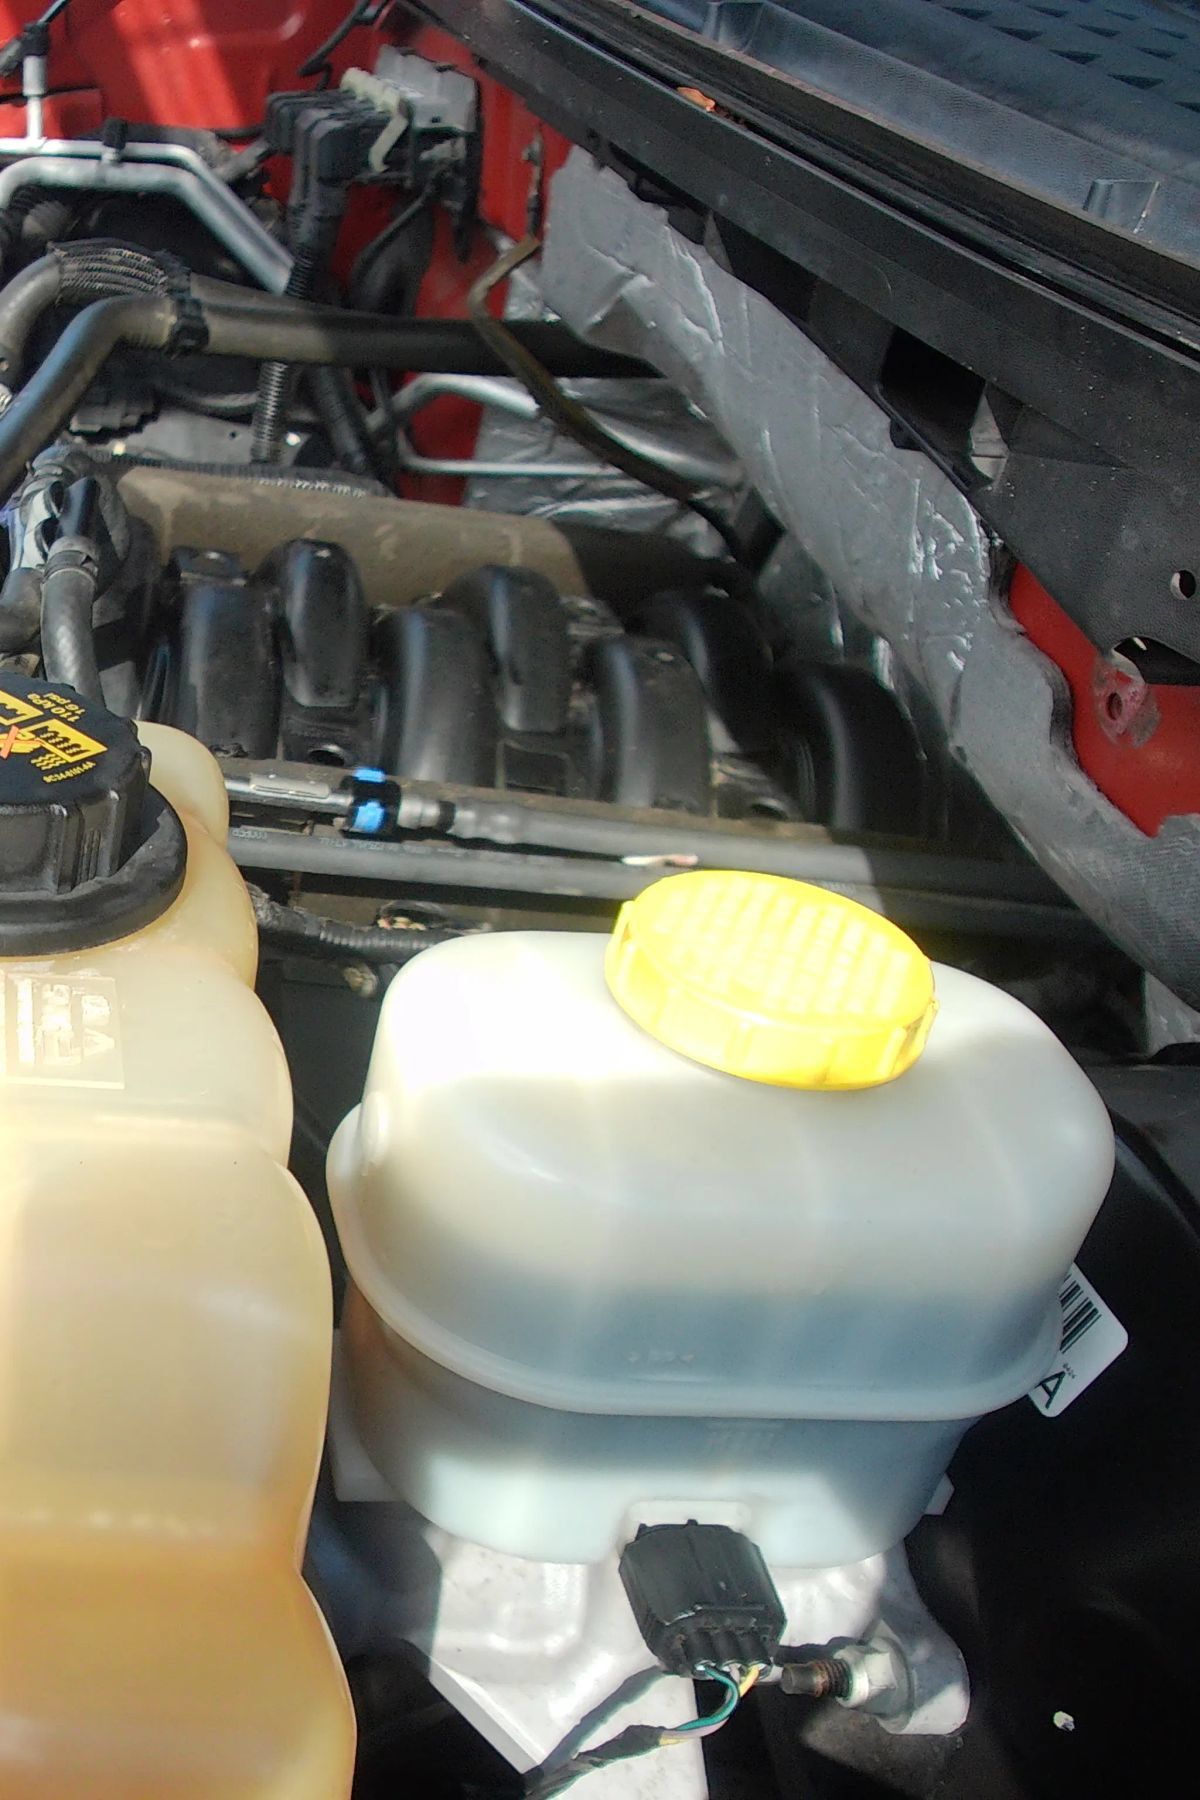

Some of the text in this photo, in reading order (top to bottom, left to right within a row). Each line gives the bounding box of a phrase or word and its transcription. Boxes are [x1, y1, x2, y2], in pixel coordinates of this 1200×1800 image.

[26, 692, 81, 723] 110 kPa
[42, 692, 86, 715] 16 psi
